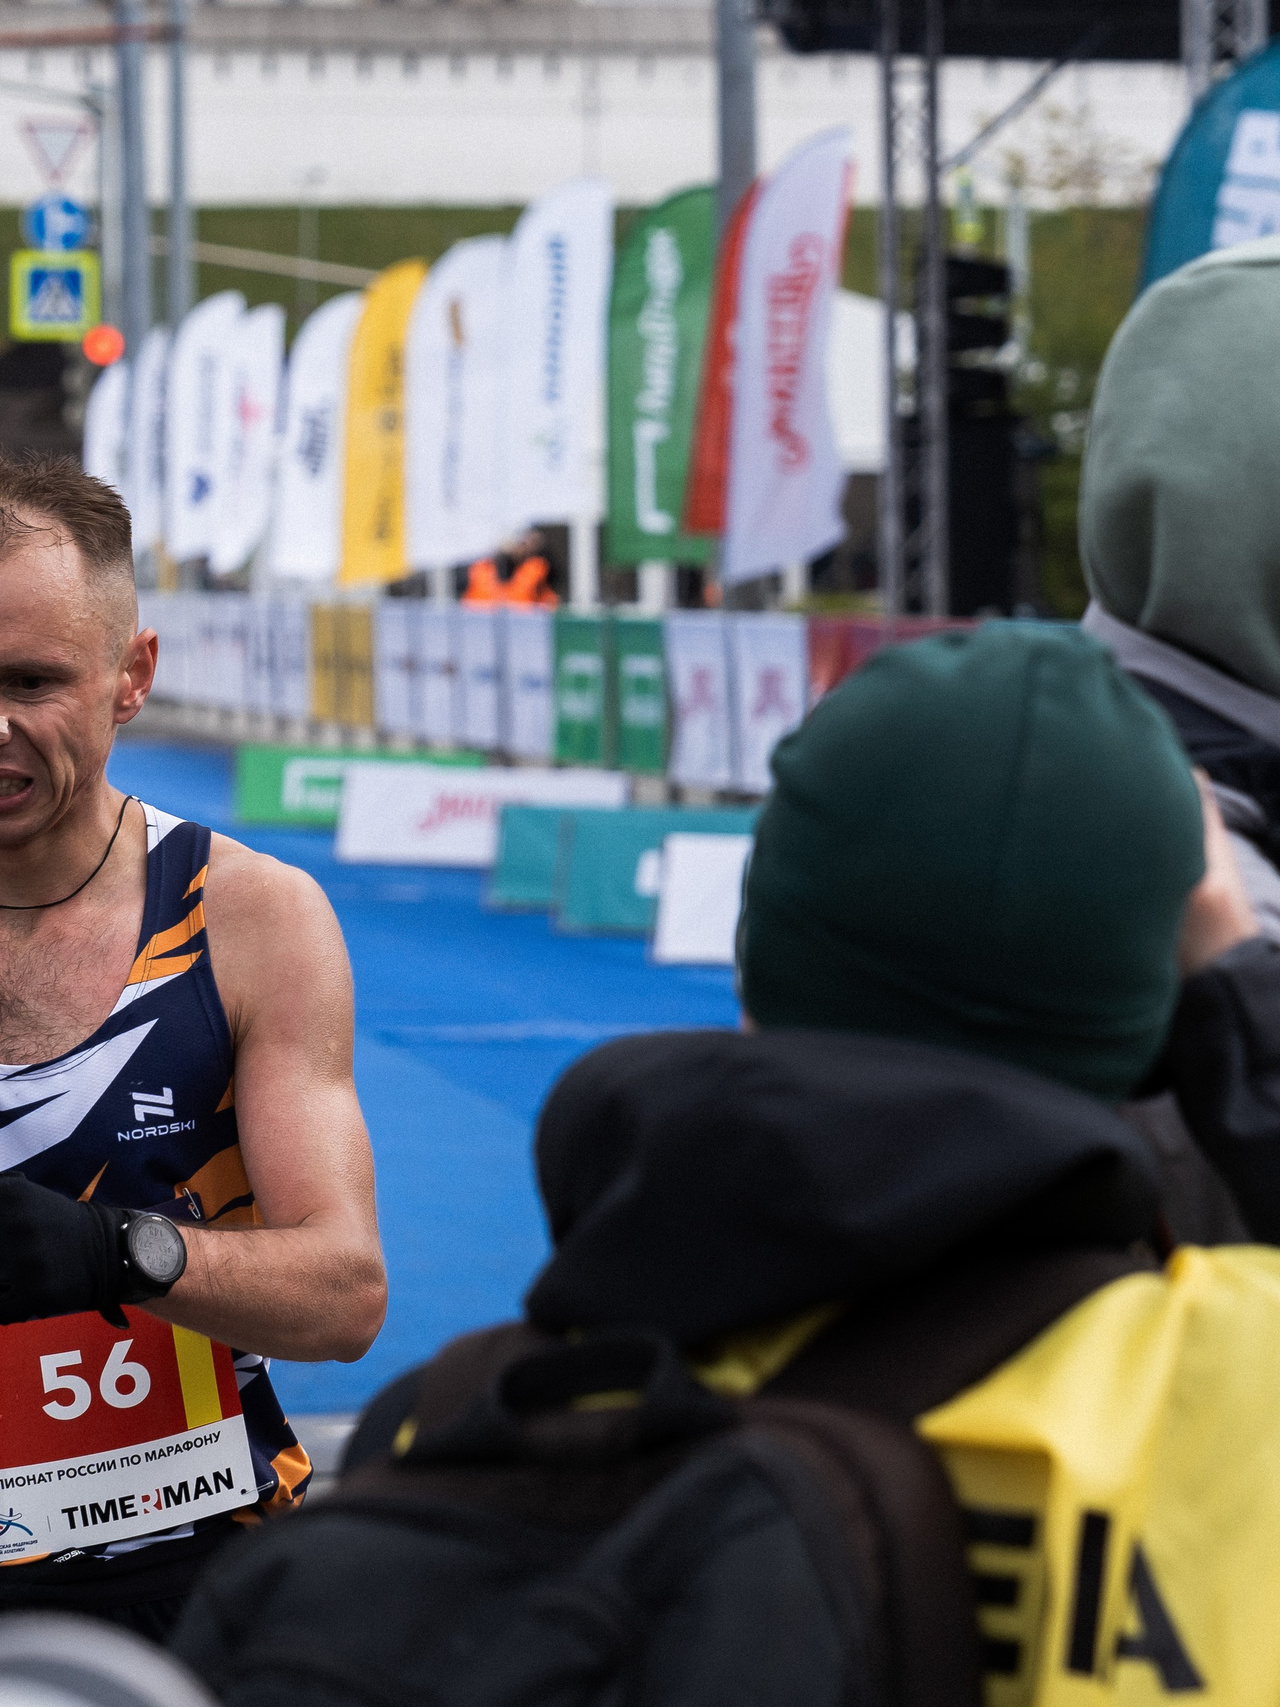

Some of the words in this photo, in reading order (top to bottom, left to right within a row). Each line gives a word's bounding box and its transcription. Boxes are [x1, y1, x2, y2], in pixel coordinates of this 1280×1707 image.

[117, 1119, 195, 1142] NORDSKI
[39, 1338, 151, 1421] 56
[57, 1459, 117, 1481] РОССИИ
[120, 1454, 142, 1468] ПО
[144, 1431, 221, 1463] МАРАФОНУ
[61, 1467, 235, 1530] TIMERMAN
